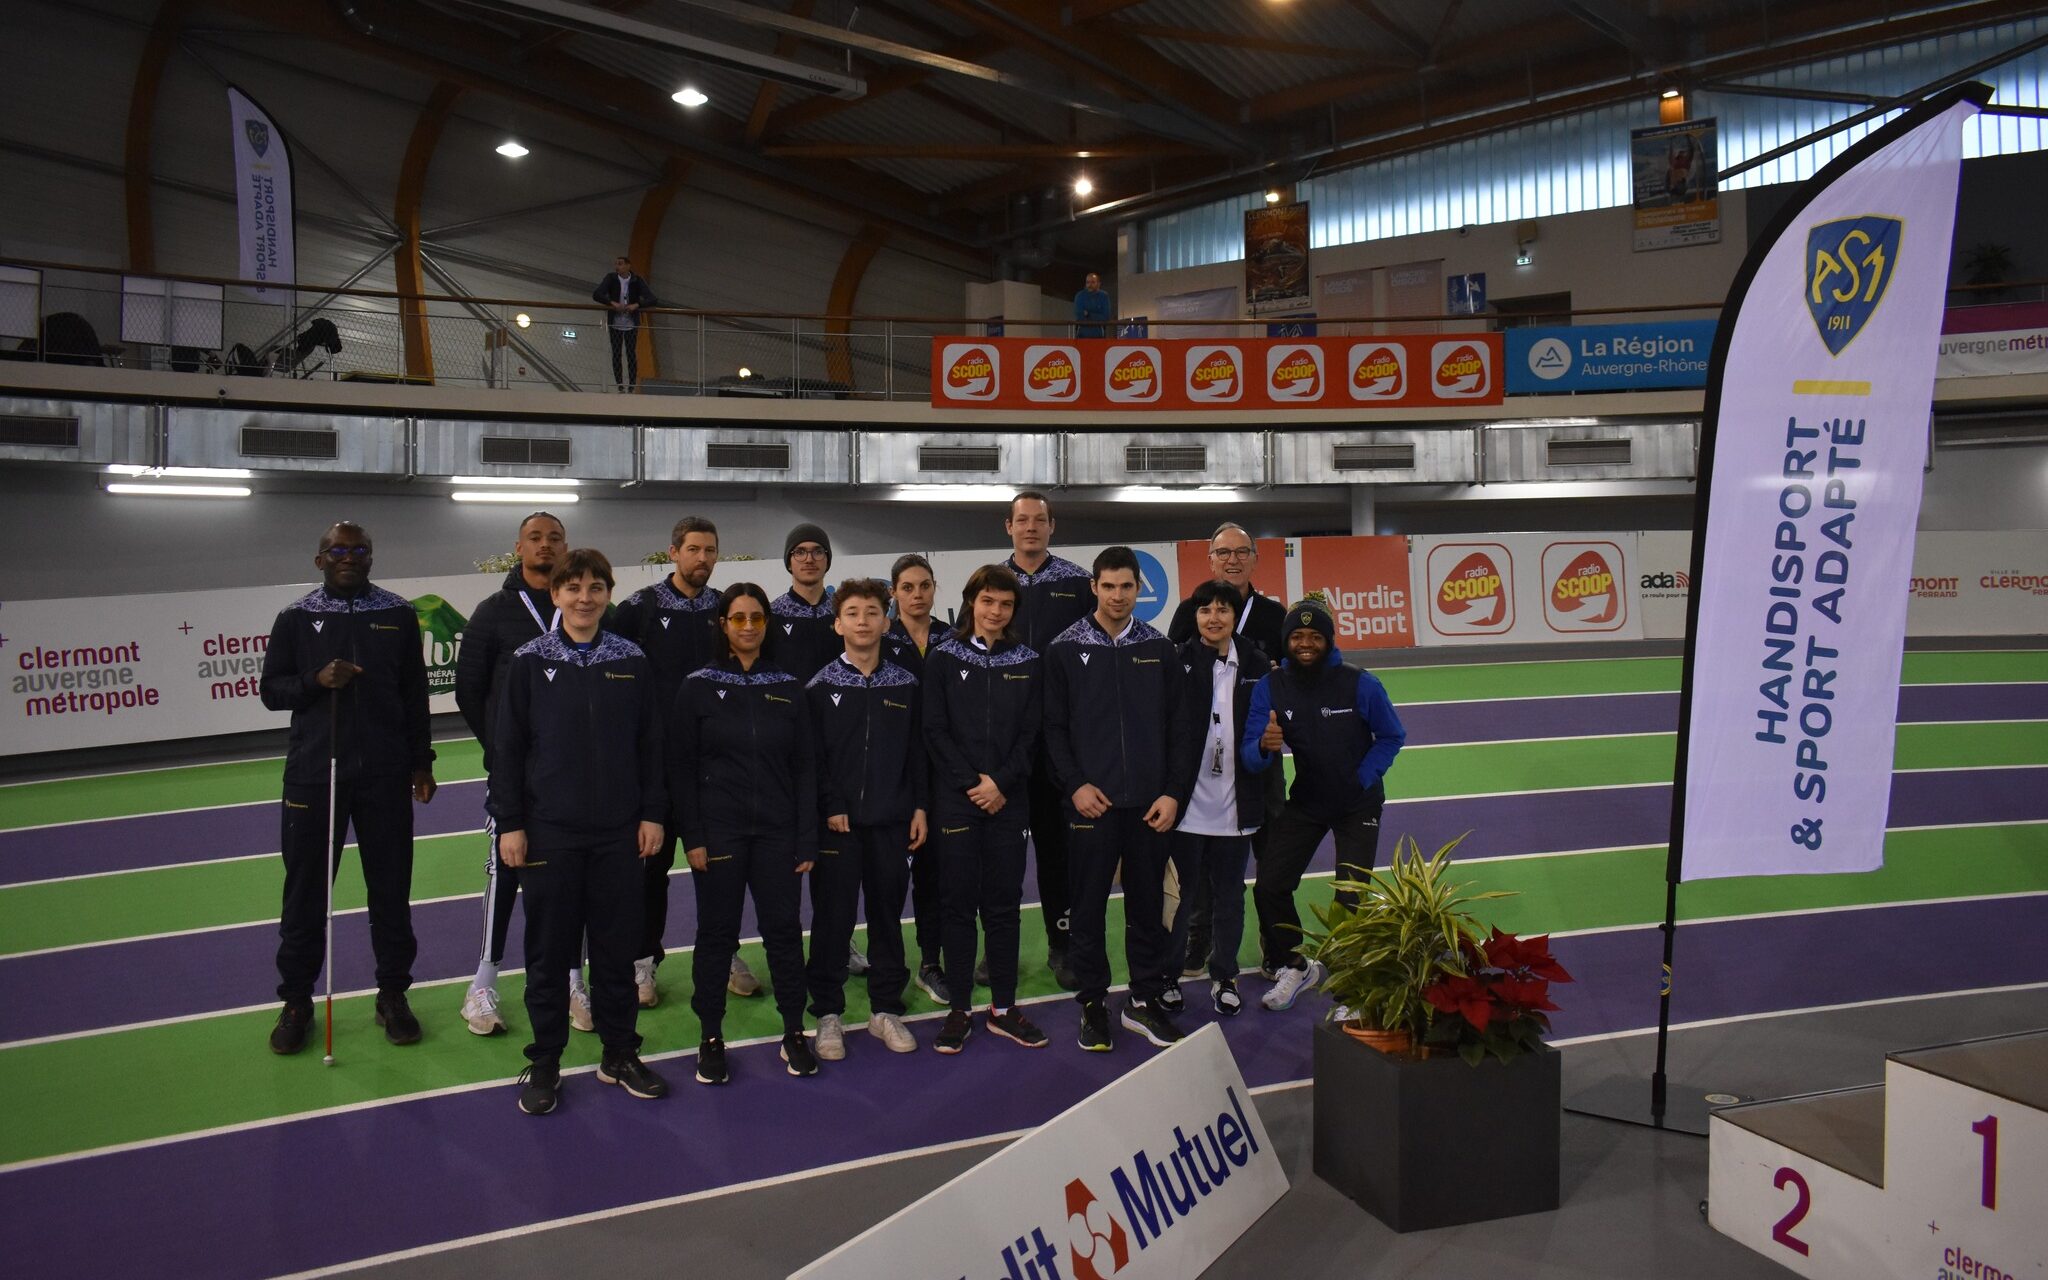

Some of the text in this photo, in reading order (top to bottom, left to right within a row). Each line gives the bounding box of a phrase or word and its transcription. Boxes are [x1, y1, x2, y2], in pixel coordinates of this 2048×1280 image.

[1828, 315, 1850, 330] 1911
[1581, 336, 1694, 357] La Région
[967, 357, 985, 365] radio
[1048, 359, 1066, 367] radio
[1129, 359, 1146, 367] radio
[1211, 359, 1227, 367] radio
[1291, 357, 1309, 366] radio
[1373, 355, 1391, 364] radio
[1456, 354, 1474, 363] radio
[952, 364, 992, 378] SCOOP
[1033, 365, 1073, 381] SCOOP
[1114, 366, 1154, 382] SCOOP
[1195, 366, 1235, 382] SCOOP
[1276, 364, 1316, 380] SCOOP
[1358, 362, 1398, 379] SCOOP
[1441, 360, 1481, 377] SCOOP
[1581, 359, 1707, 376] Auvergne-Rhône
[1465, 565, 1488, 578] radio
[1578, 563, 1600, 576] radio
[1442, 575, 1500, 601] SCOOP
[1556, 573, 1612, 599] SCOOP
[1641, 572, 1674, 588] ada
[1755, 416, 1819, 744] HANDISPORT
[1322, 585, 1405, 610] Nordic
[1338, 612, 1407, 640] Sport
[1791, 419, 1866, 851] & SPORT ADAPTÉ
[203, 633, 271, 656] clerm
[19, 641, 141, 670] clermont
[198, 656, 265, 679] auver
[427, 669, 456, 678] INÉRAL
[12, 667, 133, 694] auvergne
[211, 676, 259, 700] mét
[428, 678, 456, 686] RELLE
[26, 684, 160, 716] métropole
[1110, 1086, 1260, 1251] Mutuel
[1972, 1114, 1999, 1212] 1
[1772, 1167, 1811, 1257] 2
